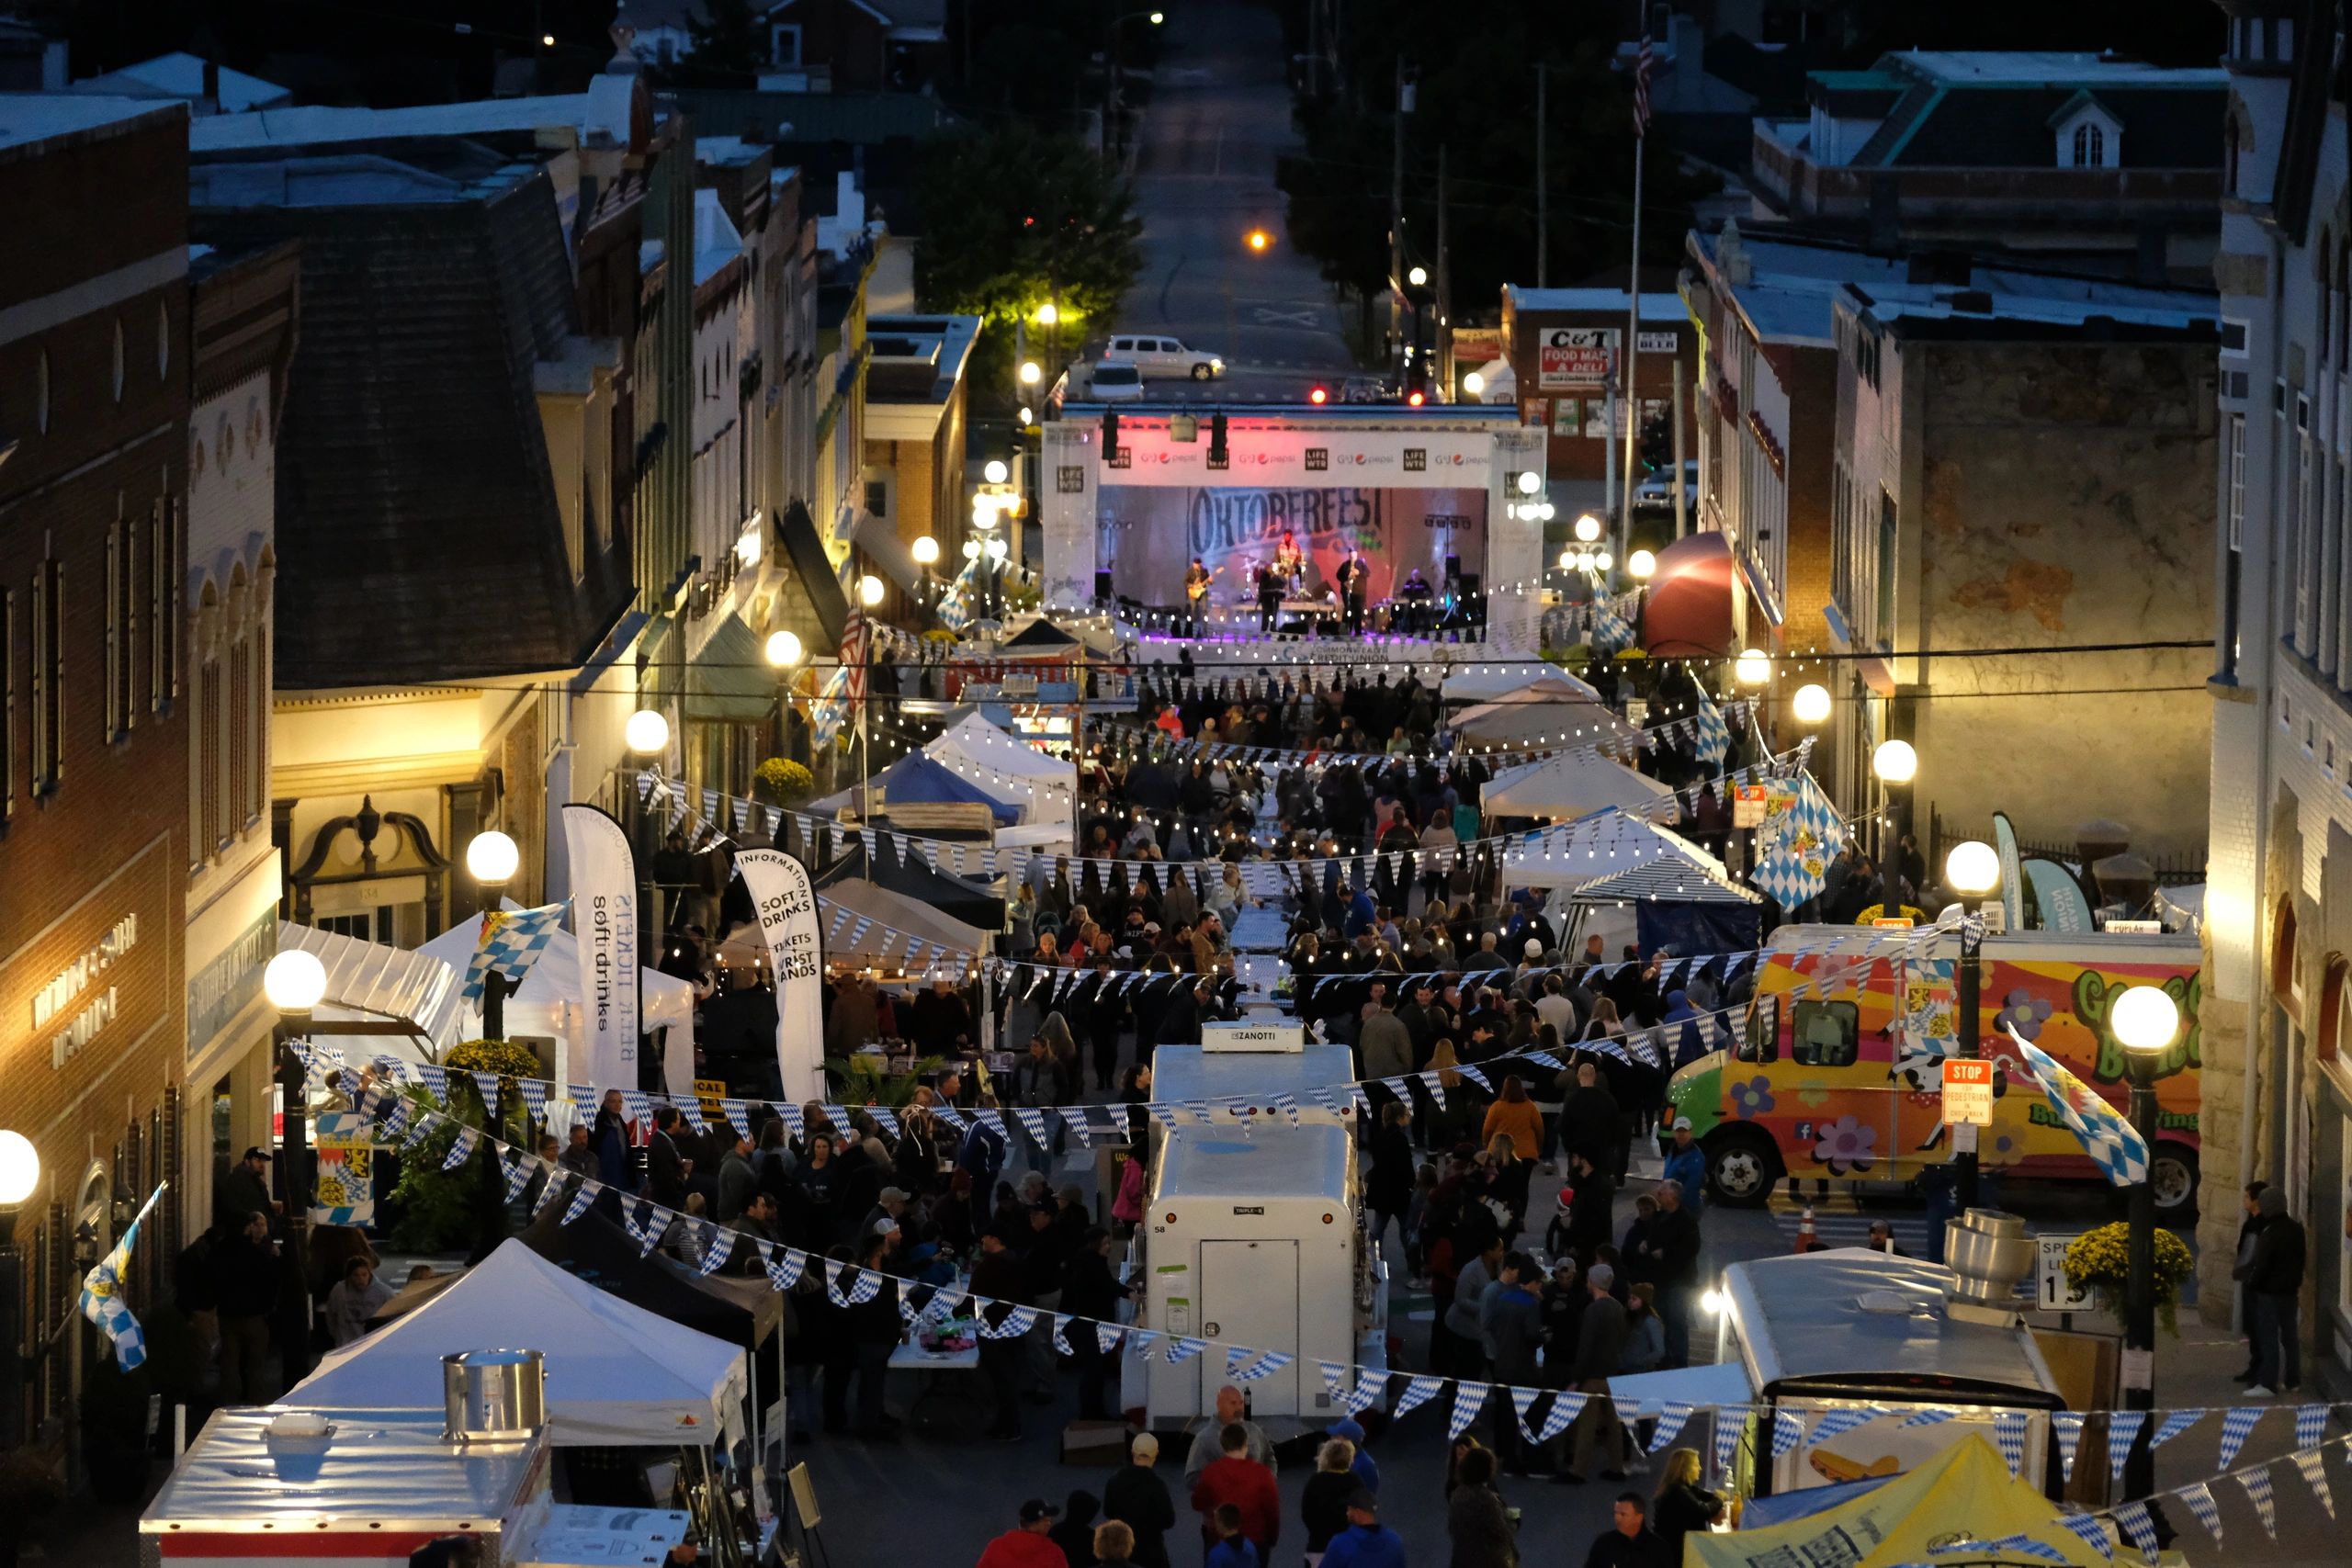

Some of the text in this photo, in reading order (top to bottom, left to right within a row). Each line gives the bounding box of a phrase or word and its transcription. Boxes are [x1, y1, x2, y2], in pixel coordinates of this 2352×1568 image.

[1544, 350, 1608, 361] FOOD MAR
[1572, 363, 1603, 371] DELI
[1405, 451, 1425, 459] LIFE
[1191, 487, 1382, 553] OKTOBERFEST
[1351, 654, 1388, 662] UNION
[741, 854, 808, 897] INFORMATION
[761, 891, 796, 912] SOFT
[763, 900, 810, 929] DRINKS
[773, 932, 811, 953] TIKETS
[777, 964, 817, 984] ANDS
[1239, 1032, 1275, 1041] ZANOTTI
[1952, 1066, 1983, 1079] STOP
[1946, 1091, 1989, 1102] PEDESTRIAN
[2042, 1243, 2070, 1254] SPE
